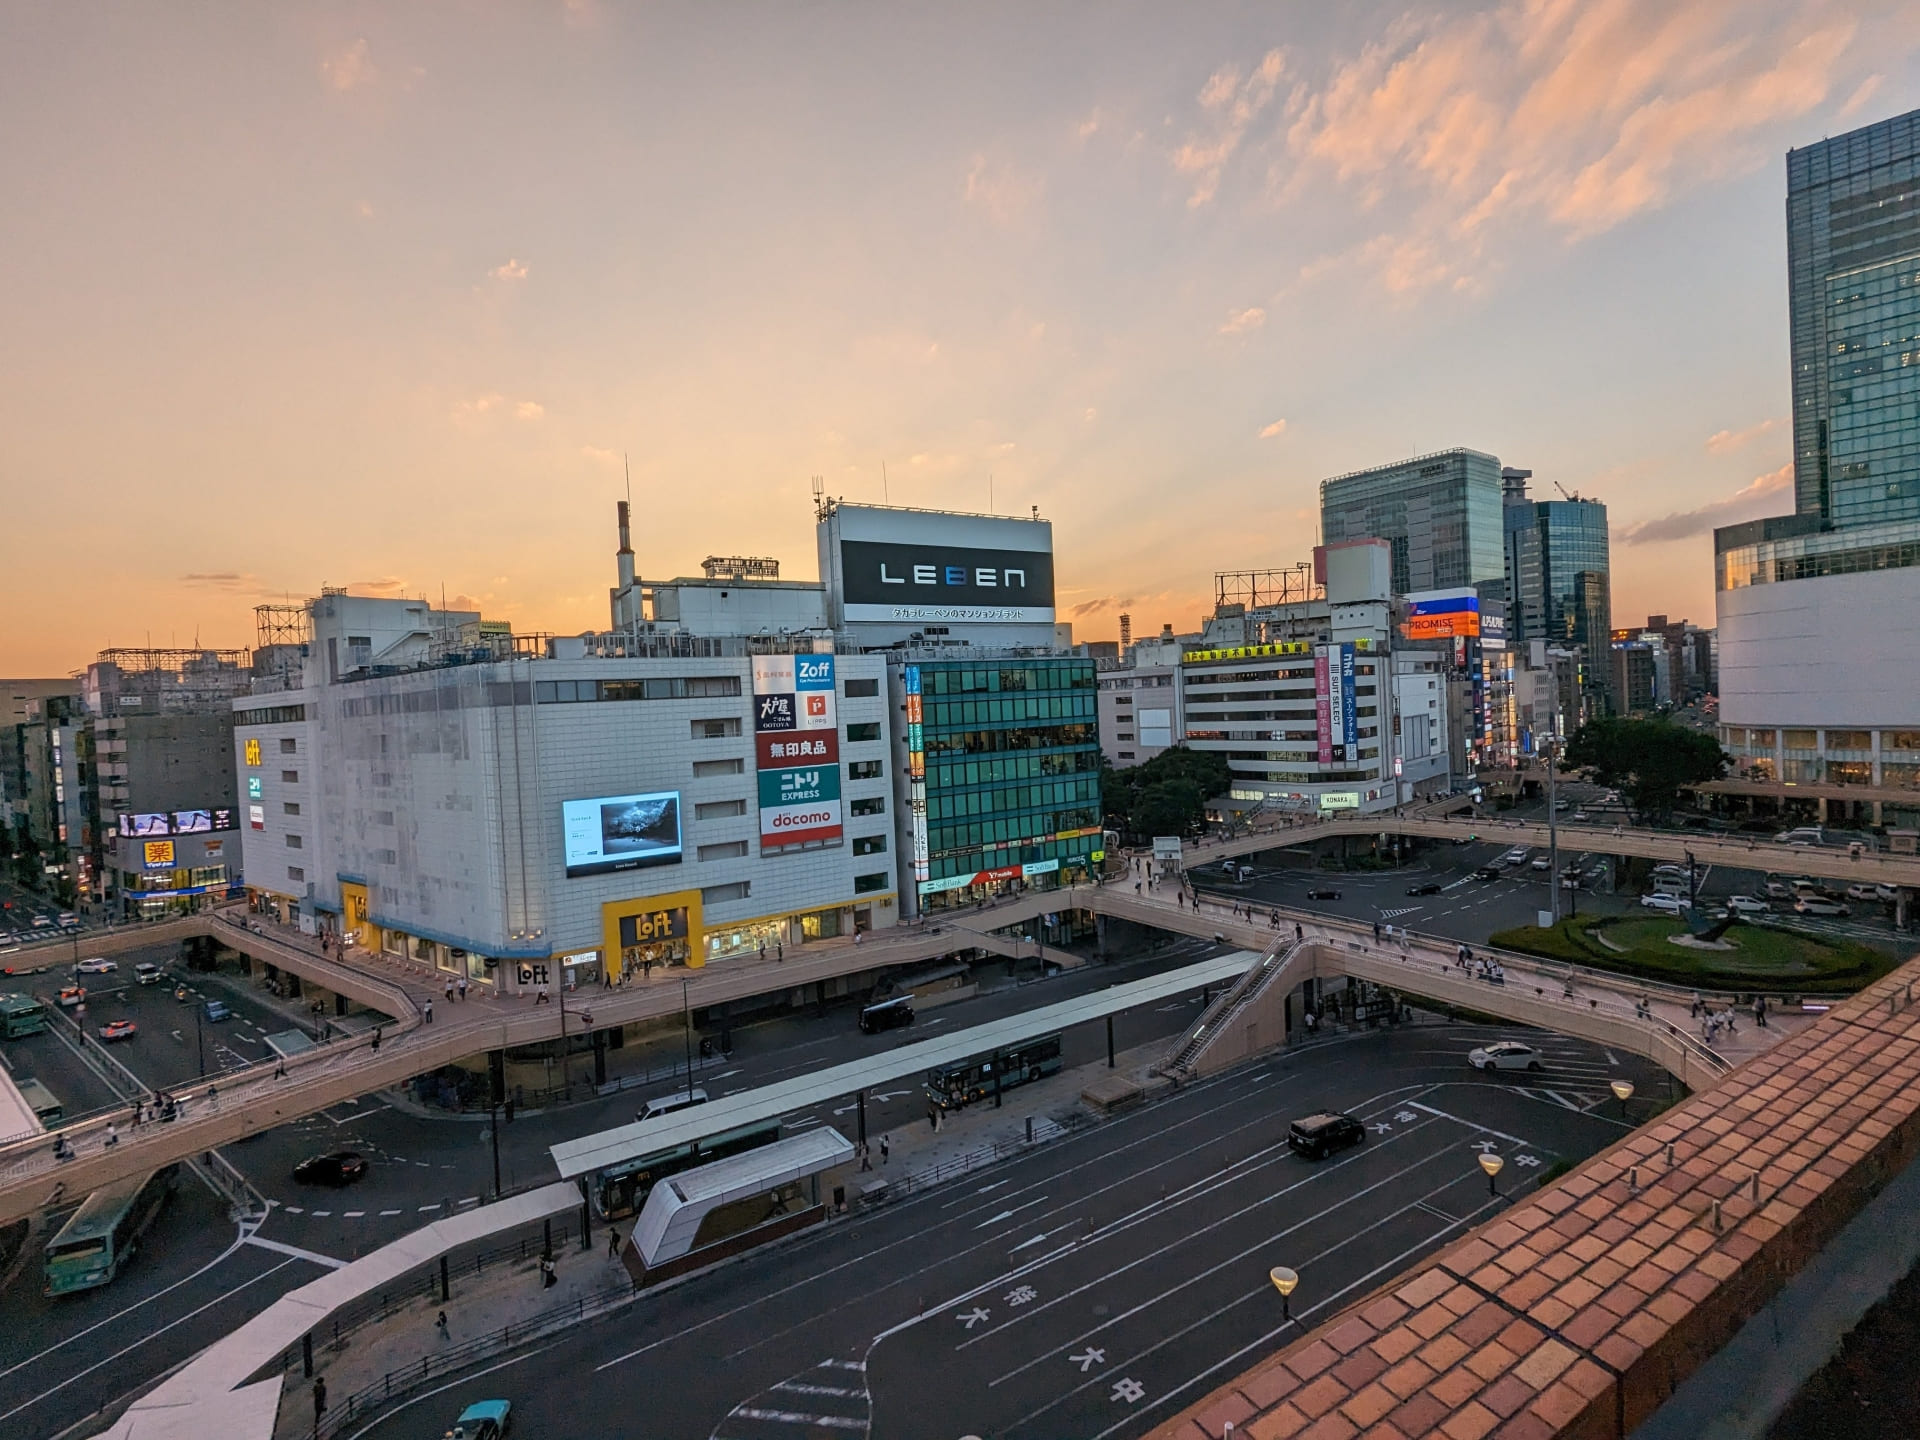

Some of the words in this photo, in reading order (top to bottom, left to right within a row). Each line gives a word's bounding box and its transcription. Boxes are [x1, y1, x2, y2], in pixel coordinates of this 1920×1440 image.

[892, 607, 1024, 619] タカラレーベンのマンションブランド
[1409, 617, 1454, 630] PROMISE
[799, 662, 829, 678] Zoff
[1343, 653, 1353, 677] コナカ
[1331, 676, 1339, 694] SUIT
[761, 696, 791, 719] 大戸屋
[1333, 696, 1341, 725] SELECT
[770, 741, 828, 758] 無印良品
[1320, 749, 1331, 757] 1F
[781, 771, 820, 790] ニトリ
[781, 789, 820, 800] EXPRESS
[1326, 796, 1348, 804] KONAKA
[773, 812, 831, 828] docomo
[148, 842, 171, 862] 薬
[935, 879, 962, 890] SoftBank
[1068, 1347, 1105, 1372] 大
[1110, 1377, 1146, 1403] 中
